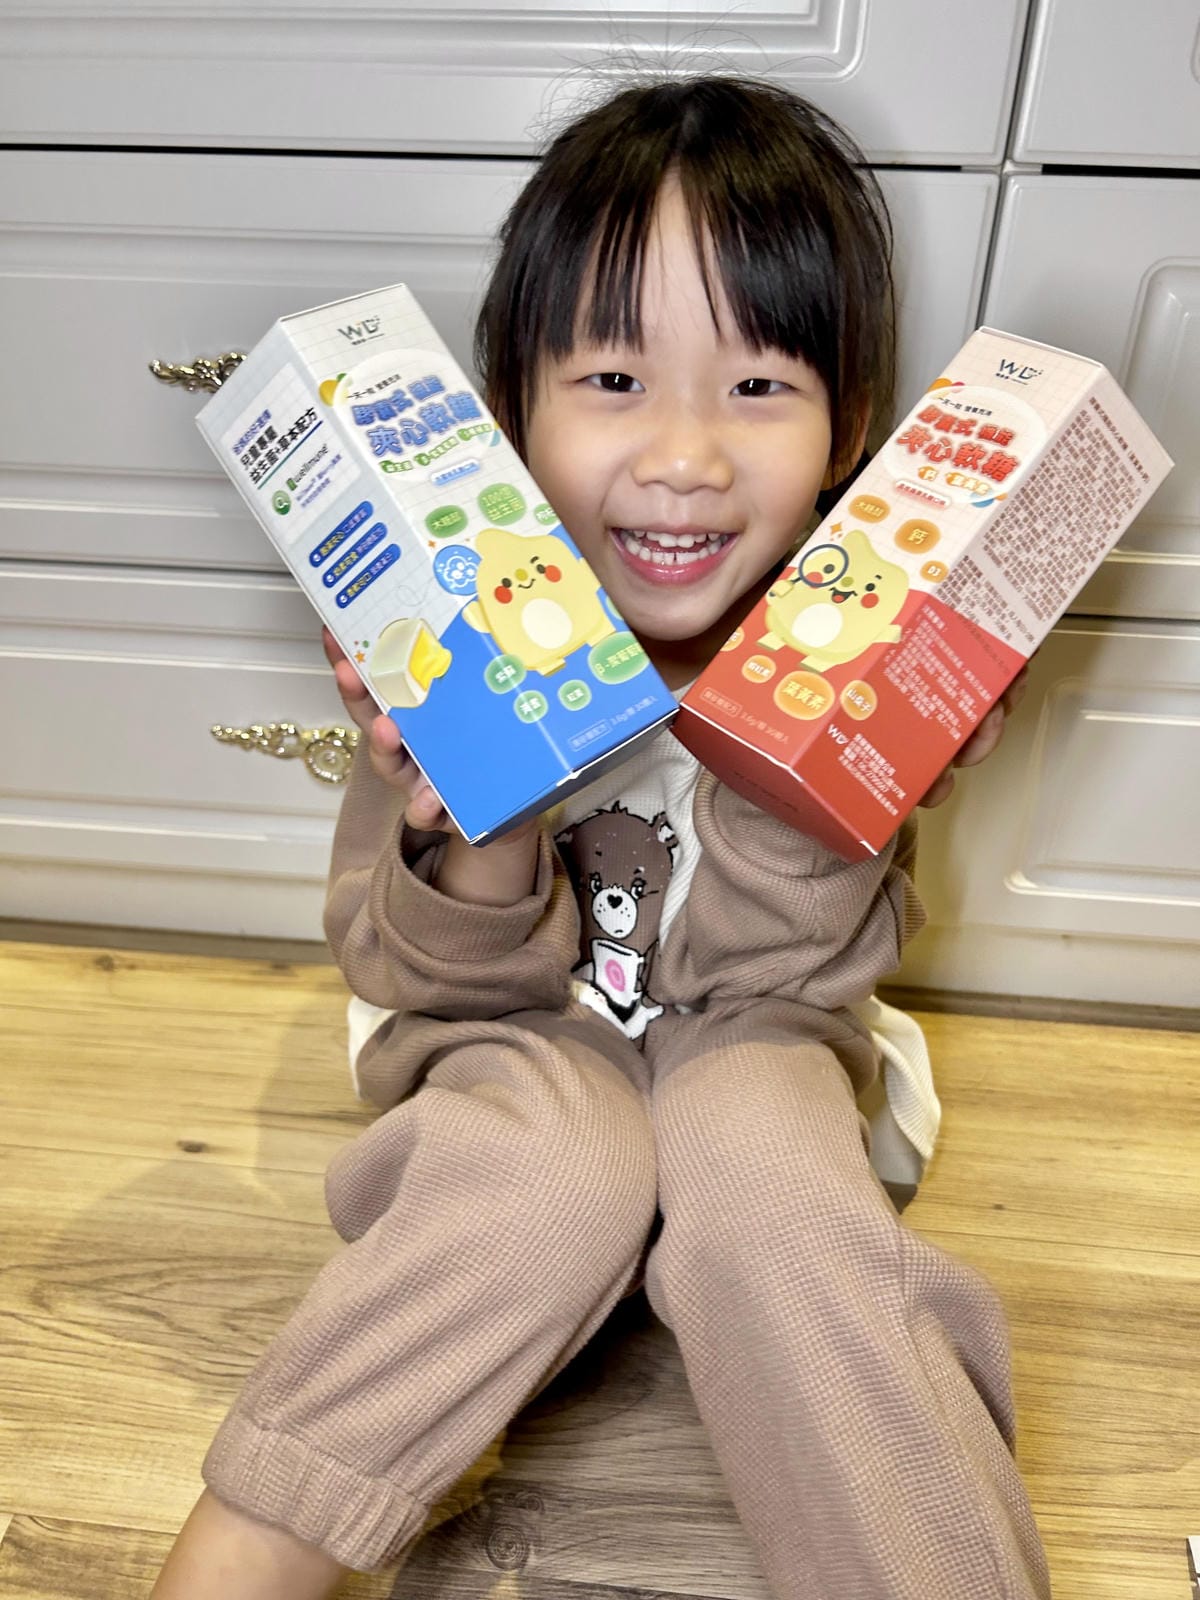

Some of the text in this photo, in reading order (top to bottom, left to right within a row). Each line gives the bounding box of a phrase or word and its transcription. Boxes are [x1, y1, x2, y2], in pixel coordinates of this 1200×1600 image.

[365, 389, 481, 455] 夾心軟糖
[897, 425, 1019, 483] 夾心軟糖
[486, 496, 523, 520] 益生菌
[908, 527, 927, 545] 鈣
[782, 680, 827, 710] 葉黃素
